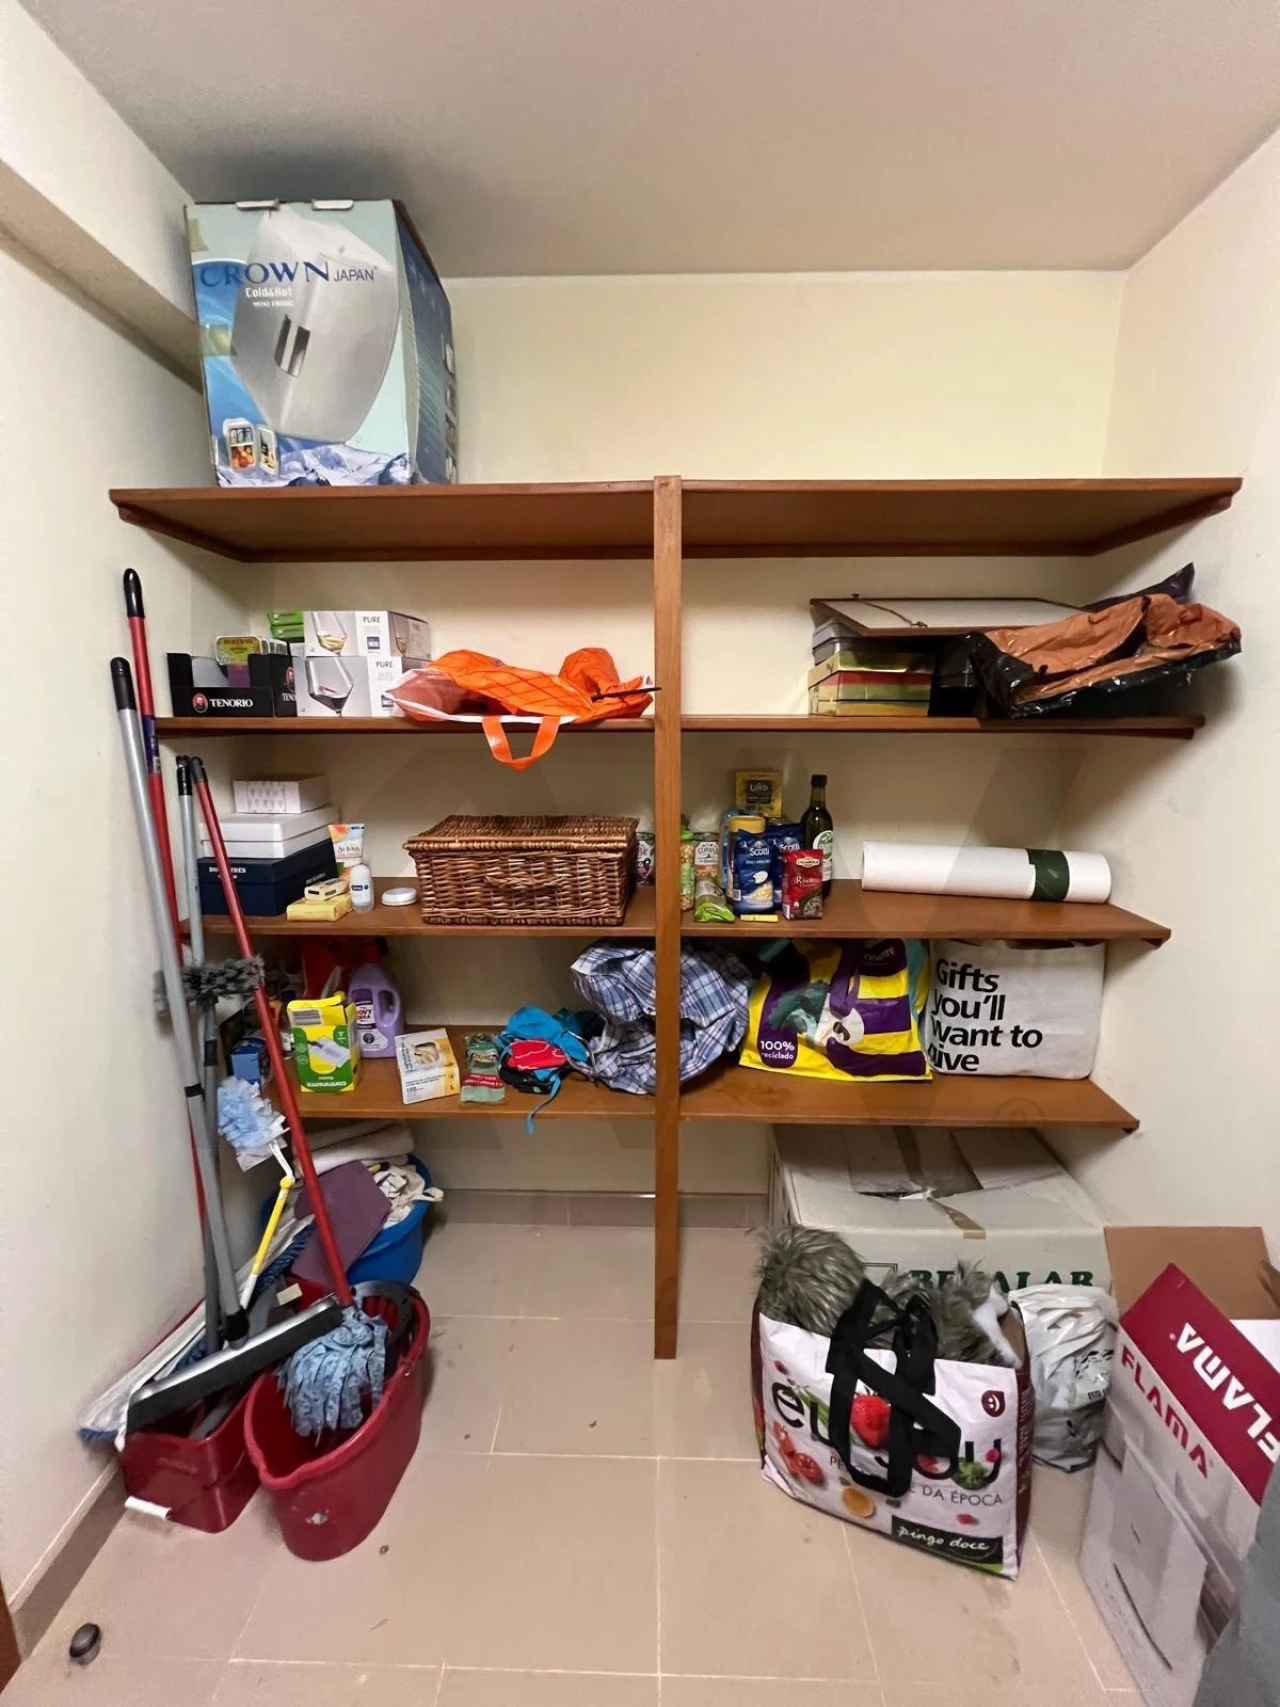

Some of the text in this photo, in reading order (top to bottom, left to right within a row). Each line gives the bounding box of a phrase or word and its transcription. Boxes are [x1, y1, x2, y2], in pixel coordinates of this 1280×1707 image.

[200, 262, 375, 288] CROWN JAPAN
[363, 616, 381, 624] PURE
[375, 660, 393, 669] PURE
[209, 698, 254, 708] TENORIO
[749, 847, 770, 857] Scotti
[936, 957, 1000, 993] Gifts
[931, 987, 1006, 1021] you'll
[930, 1015, 1043, 1049] want to
[760, 1040, 796, 1052] 100%
[761, 1051, 794, 1060] reciclado
[1177, 1322, 1280, 1464] FLAMA
[1121, 1344, 1208, 1480] FLAMA
[922, 1486, 945, 1502] DA
[950, 1490, 1004, 1506] ÉPOCA
[895, 1525, 991, 1551] pingo doce
